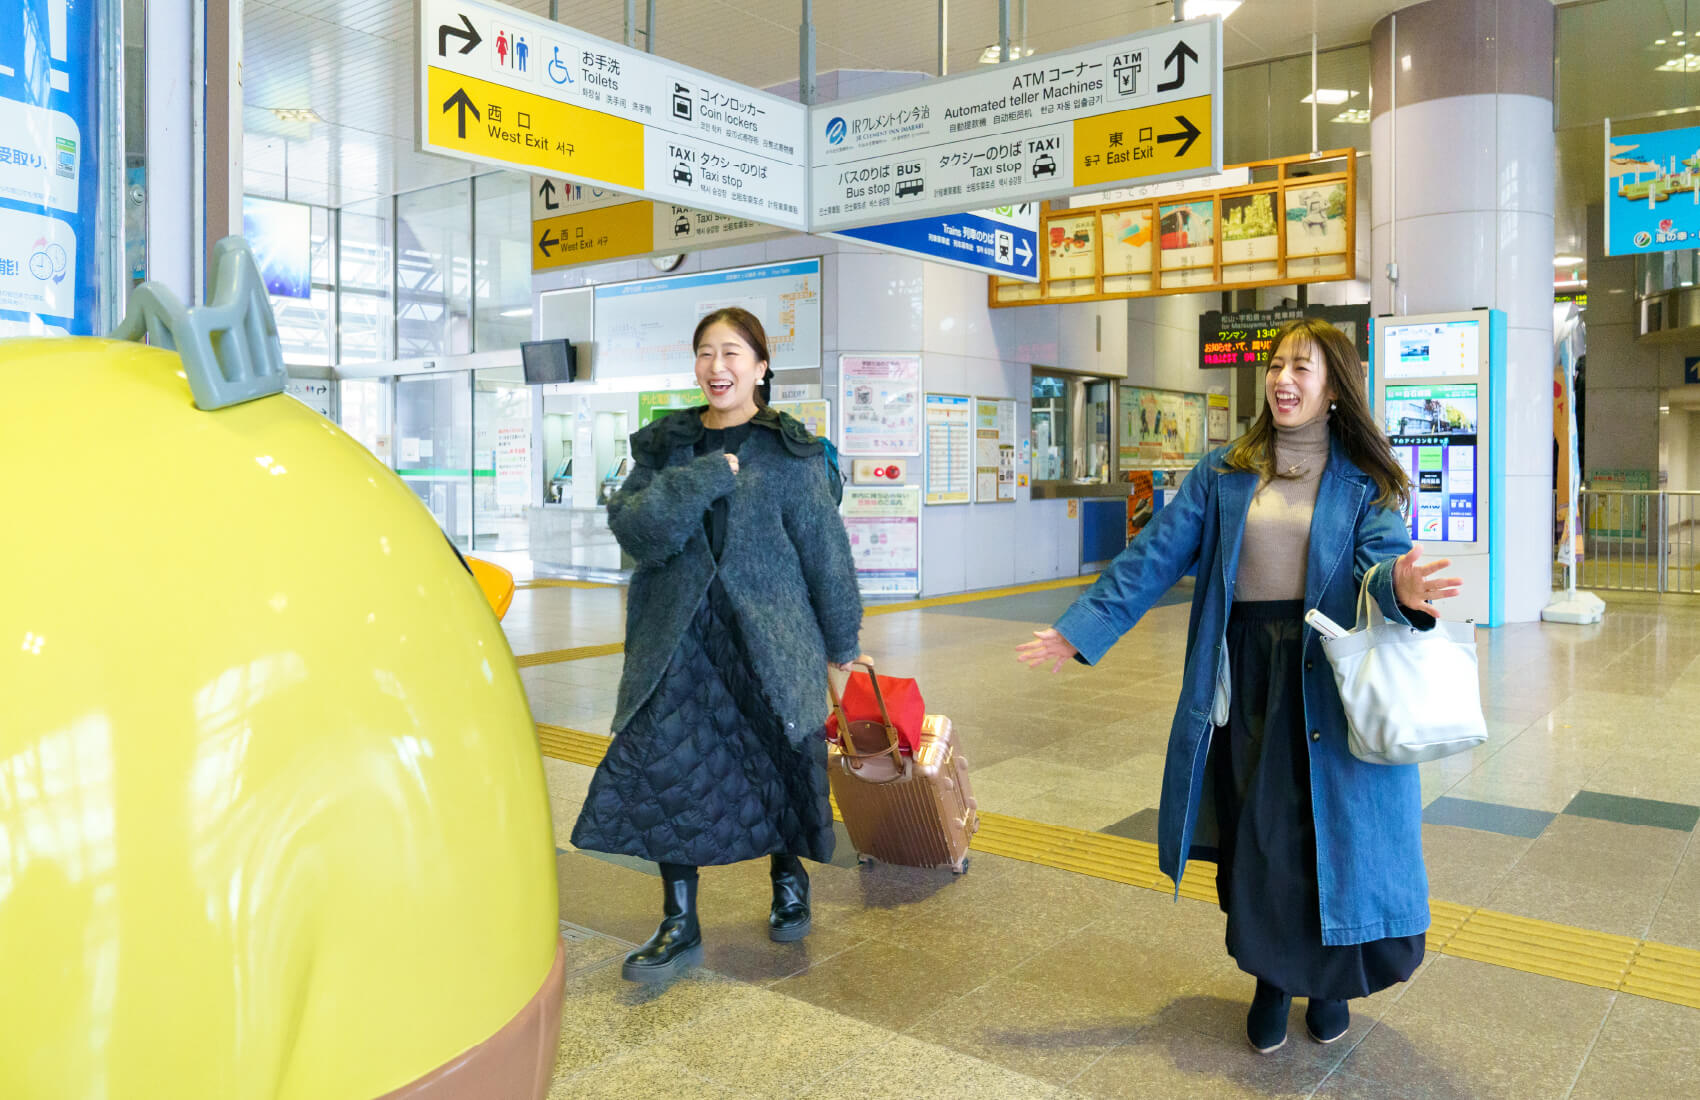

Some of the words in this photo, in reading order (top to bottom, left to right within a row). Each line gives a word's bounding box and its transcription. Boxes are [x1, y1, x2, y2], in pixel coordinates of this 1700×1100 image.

[583, 51, 621, 76] お手洗
[1113, 52, 1142, 67] ATM
[582, 69, 619, 91] Toilets
[1012, 70, 1045, 90] ATM
[1049, 61, 1103, 82] コーナー
[700, 88, 766, 116] コインロッカー
[944, 99, 1006, 120] Automated
[1010, 92, 1040, 106] teller
[1043, 79, 1103, 99] Machines
[700, 105, 721, 121] Coin
[724, 112, 758, 132] lockers
[488, 124, 521, 144] West
[525, 134, 549, 151] Exit
[556, 142, 575, 157] 서구
[1028, 137, 1060, 153] TAXI
[669, 145, 696, 162] TAXI
[939, 141, 1022, 168] タクシーのりば
[1106, 151, 1130, 165] East
[1133, 146, 1154, 161] Exit
[701, 152, 768, 179] タクシーのりば
[839, 165, 890, 185] バスのりば
[897, 163, 921, 176] BUS
[970, 165, 993, 178] Taxi
[996, 162, 1022, 177] stop
[700, 167, 719, 182] Taxi
[722, 175, 743, 189] stop
[846, 187, 865, 198] Bus
[867, 183, 890, 195] stop
[696, 213, 713, 224] Taxi
[942, 223, 962, 238] Trains
[962, 226, 995, 245] 列車のりば
[561, 242, 578, 252] West
[580, 239, 593, 250] Exit
[1218, 331, 1247, 341] ワンマン
[1256, 328, 1280, 338] 13:0
